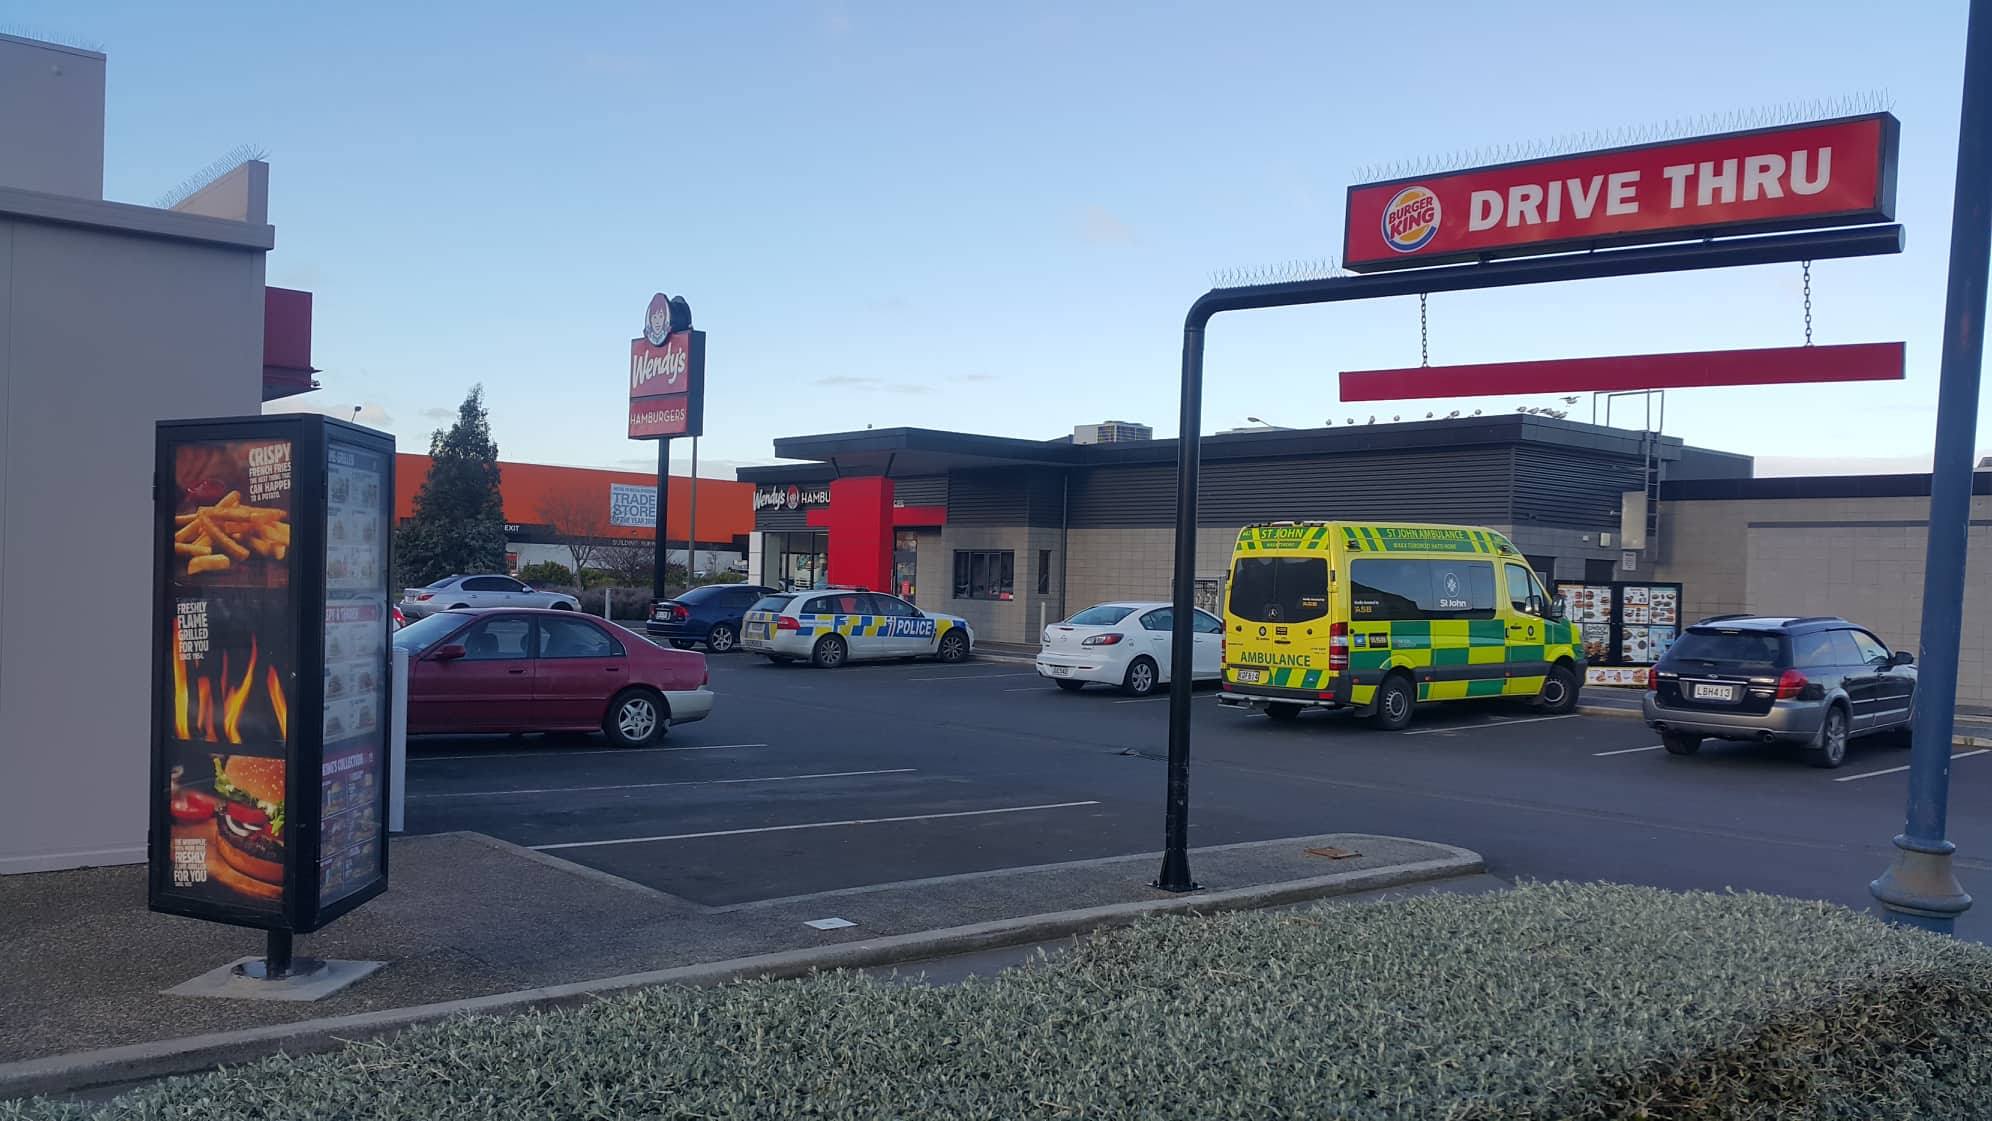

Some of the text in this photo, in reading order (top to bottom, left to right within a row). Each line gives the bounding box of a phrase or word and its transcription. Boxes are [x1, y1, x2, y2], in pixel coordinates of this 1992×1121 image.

[1468, 146, 1832, 232] DRIVE THRU
[1388, 196, 1433, 225] BURGER
[1390, 207, 1434, 239] KING
[632, 342, 687, 389] Wendy's
[630, 408, 686, 425] HAMBURGERS
[249, 442, 291, 467] CRISPY
[249, 462, 291, 478] FRENCH FRIES
[250, 482, 263, 495] CAN
[613, 493, 656, 506] TRADE
[752, 485, 831, 512] Wendy's HAMBU
[612, 504, 656, 517] STORE
[504, 525, 520, 533] EXIT
[1261, 529, 1273, 539] ST
[1274, 528, 1304, 539] JOHN
[1386, 529, 1465, 539] ST JOHN AMBULANCE
[177, 601, 207, 615] FRESHLY
[1440, 599, 1467, 608] St John
[177, 613, 208, 629] FLAME
[896, 619, 933, 635] POLICE
[178, 628, 209, 641] GRILLED
[178, 639, 209, 653] FOR YOU
[1240, 651, 1311, 667] AMBULANCE
[1696, 687, 1731, 698] LBH413
[175, 850, 206, 864] FRESHLY
[174, 870, 208, 883] FOR YOU
